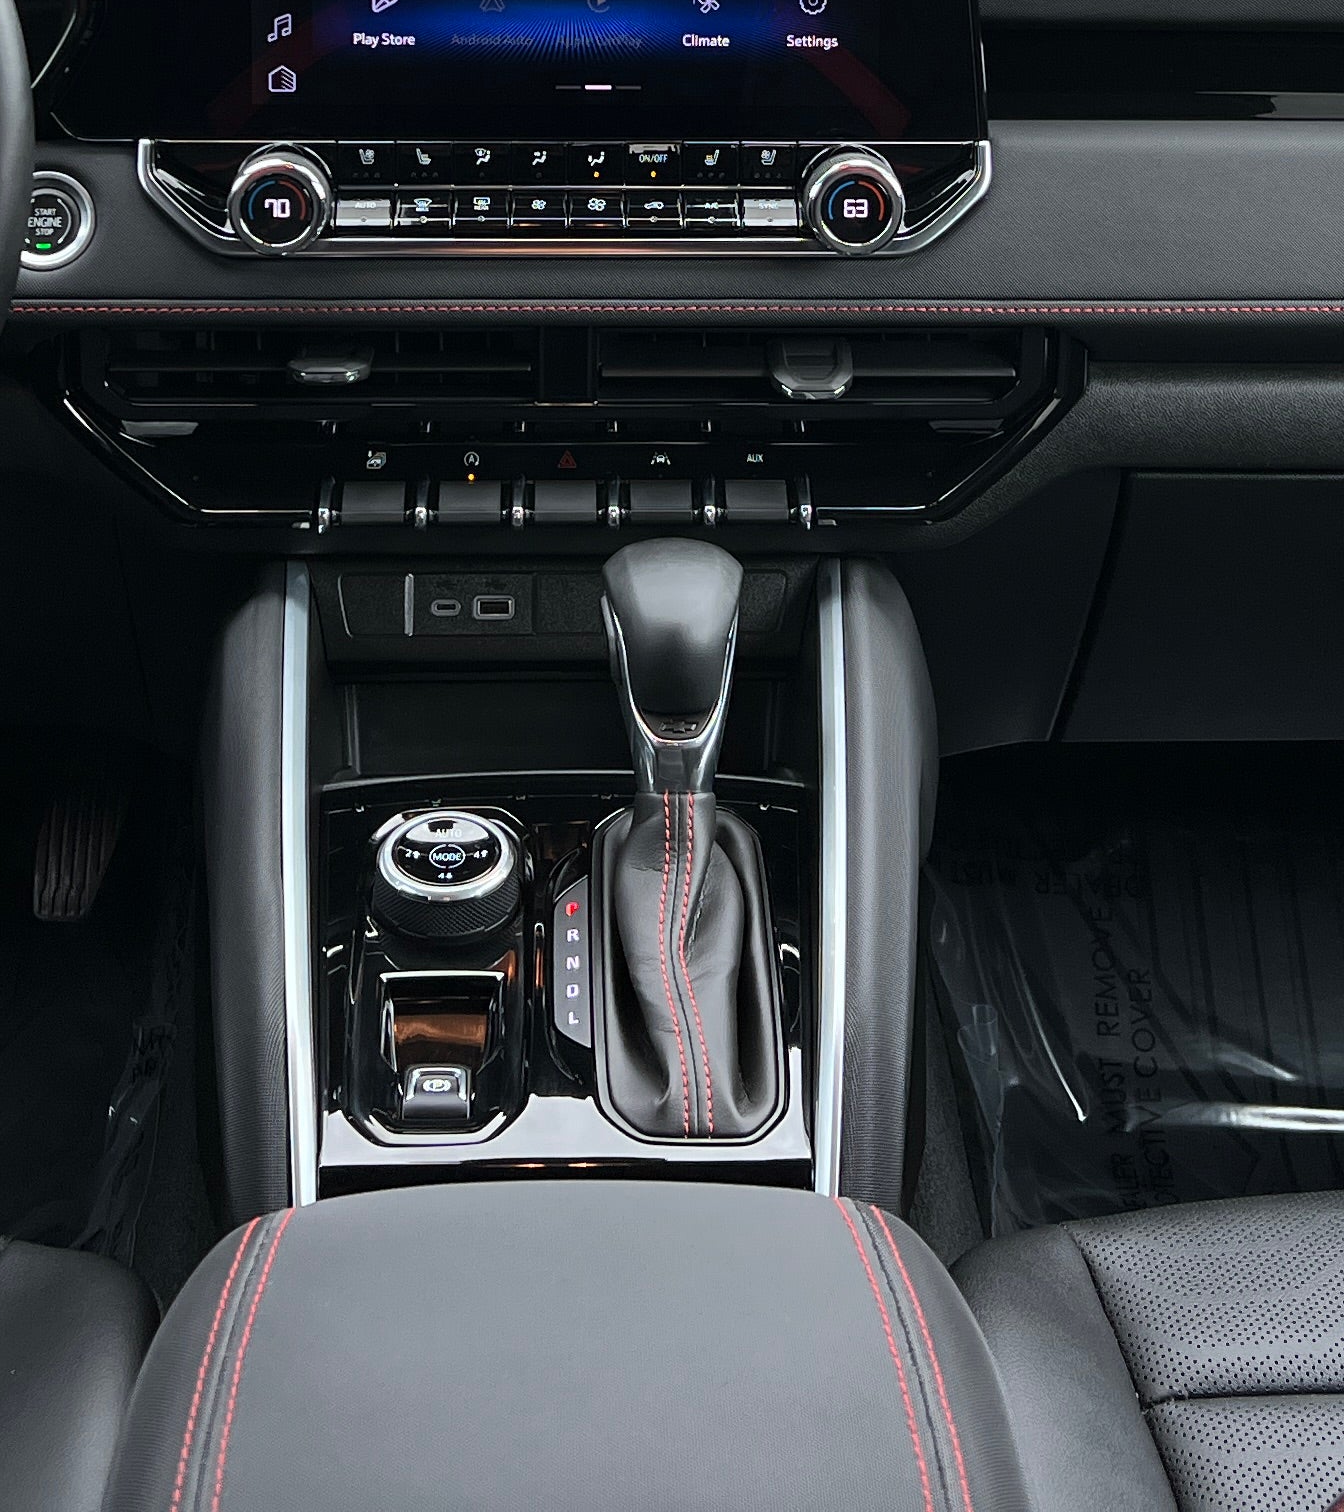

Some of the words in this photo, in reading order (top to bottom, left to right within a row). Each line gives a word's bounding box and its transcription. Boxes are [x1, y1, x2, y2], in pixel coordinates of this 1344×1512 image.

[353, 31, 378, 47] Play
[380, 31, 416, 45] Store
[682, 32, 731, 48] Climate
[786, 33, 839, 50] Settings
[638, 154, 668, 164] ON/OFF
[354, 200, 377, 209] AUTO
[34, 208, 56, 216] START
[27, 217, 62, 228] ENGINE
[35, 228, 54, 236] STOP
[747, 452, 763, 463] AUX
[435, 828, 462, 838] AUTO
[432, 852, 462, 862] MODE
[565, 901, 580, 917] P
[567, 929, 580, 942] R
[566, 956, 580, 970] N
[1087, 906, 1121, 1036] REMOVE
[567, 984, 579, 998] D
[568, 1011, 579, 1025] L
[1126, 968, 1158, 1078] COVER
[1100, 1058, 1127, 1134] MUST
